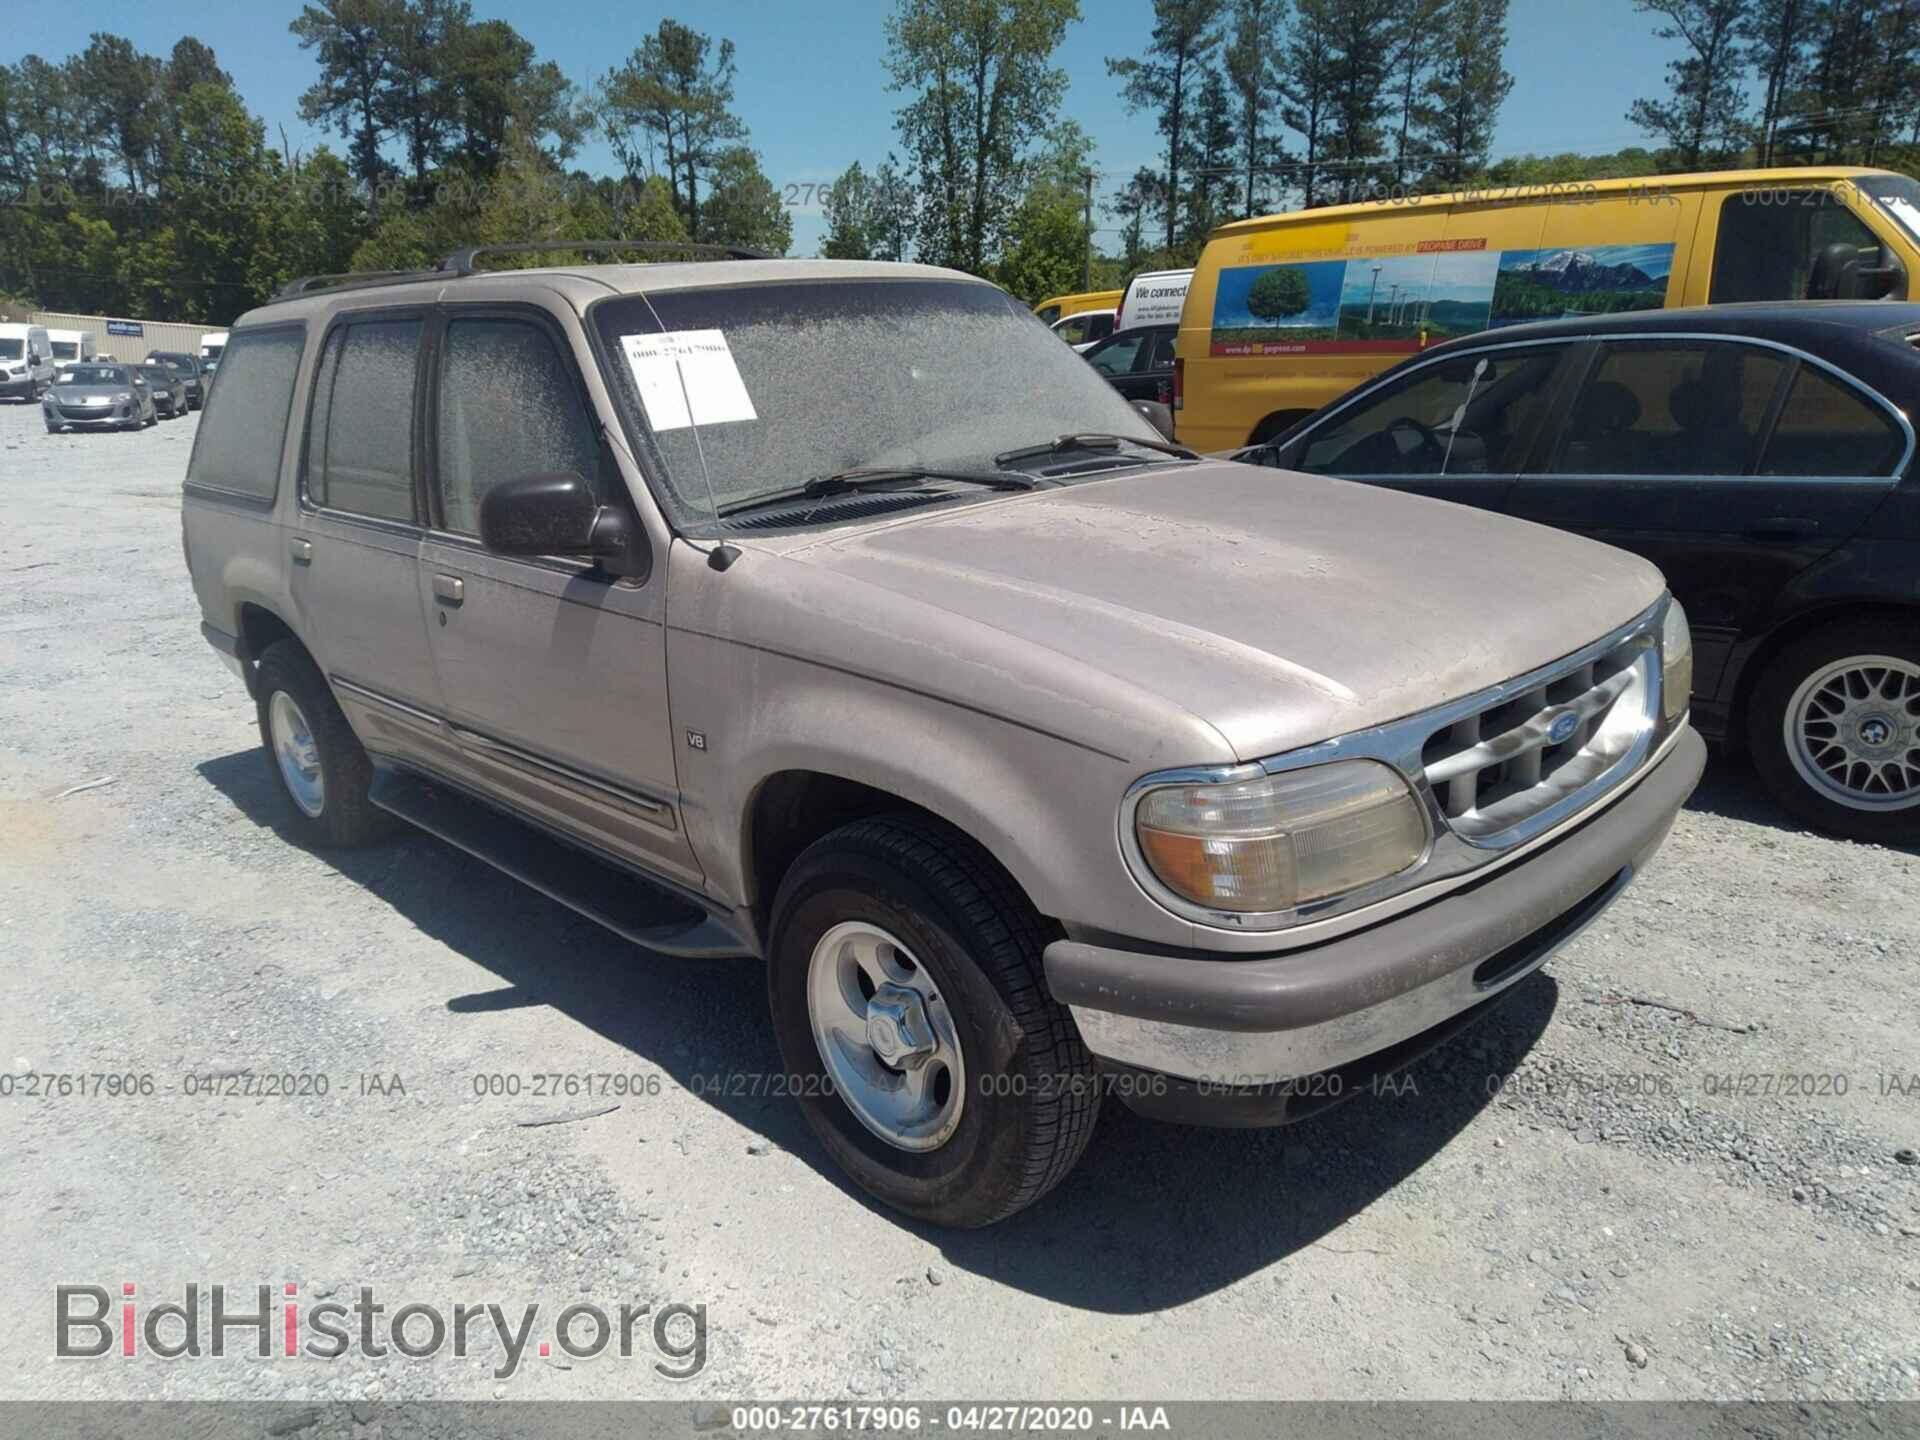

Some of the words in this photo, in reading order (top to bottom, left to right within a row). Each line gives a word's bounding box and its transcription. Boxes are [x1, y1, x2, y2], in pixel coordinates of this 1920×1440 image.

[1136, 286, 1149, 299] We
[1150, 285, 1187, 298] connect
[687, 732, 704, 748] V8
